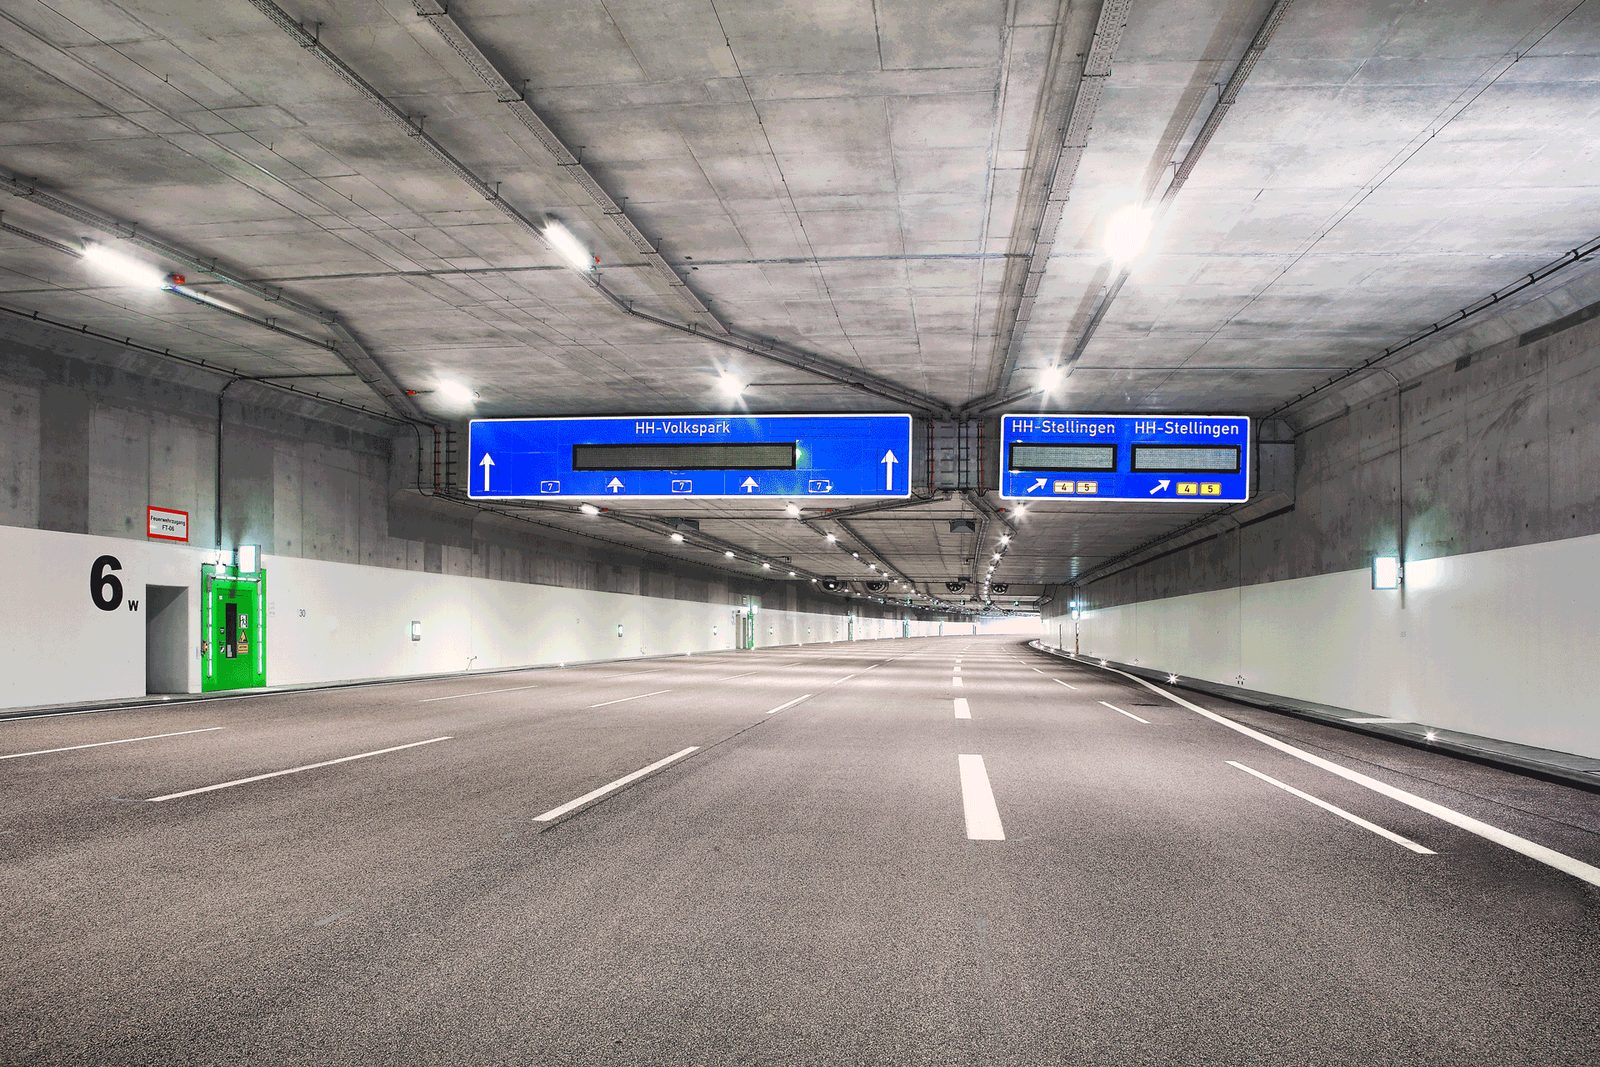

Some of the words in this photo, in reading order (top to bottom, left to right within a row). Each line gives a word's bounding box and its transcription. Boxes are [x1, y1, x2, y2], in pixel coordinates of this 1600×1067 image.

[635, 421, 730, 436] HH-Volkspark
[1012, 420, 1115, 437] HH-Stellingen
[1135, 421, 1239, 438] HH-Stellingen
[1061, 483, 1067, 491] 4
[1084, 484, 1090, 492] 5
[1184, 485, 1190, 493] 4
[1207, 485, 1213, 493] 5
[150, 515, 186, 527] Feuerwehrzugang
[90, 555, 123, 611] 6
